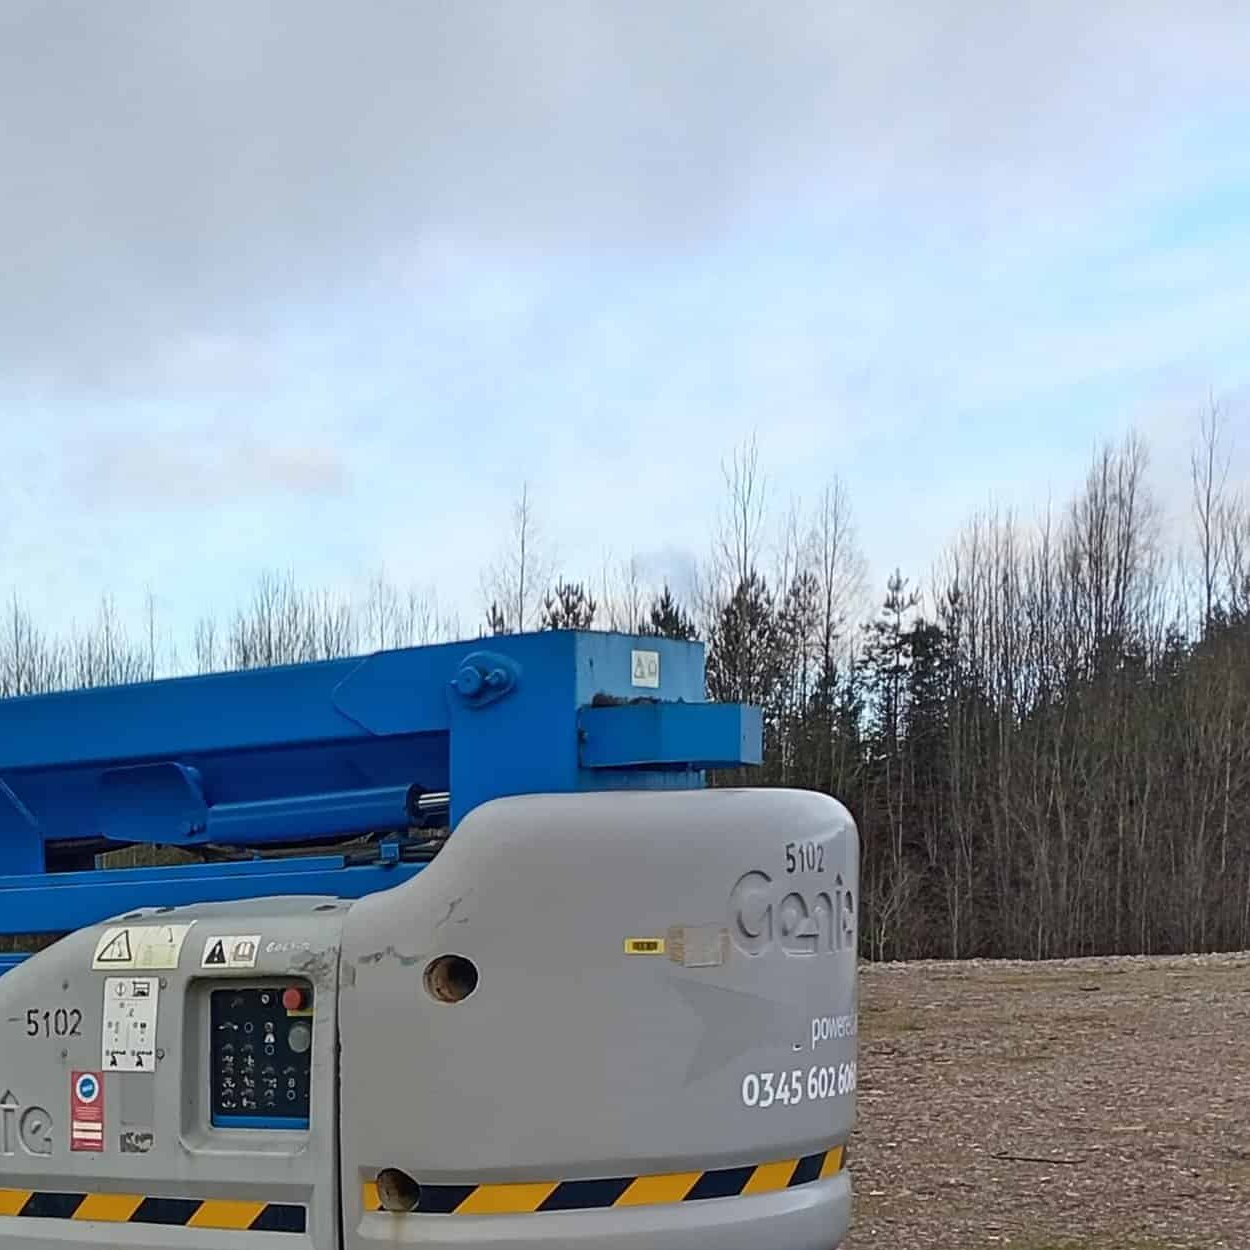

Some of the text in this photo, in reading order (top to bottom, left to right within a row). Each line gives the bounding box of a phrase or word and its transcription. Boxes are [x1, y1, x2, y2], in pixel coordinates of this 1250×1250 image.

[785, 842, 824, 873] 5102
[27, 1008, 82, 1038] 5102
[742, 1070, 803, 1107] 0345
[807, 1065, 835, 1099] 602
